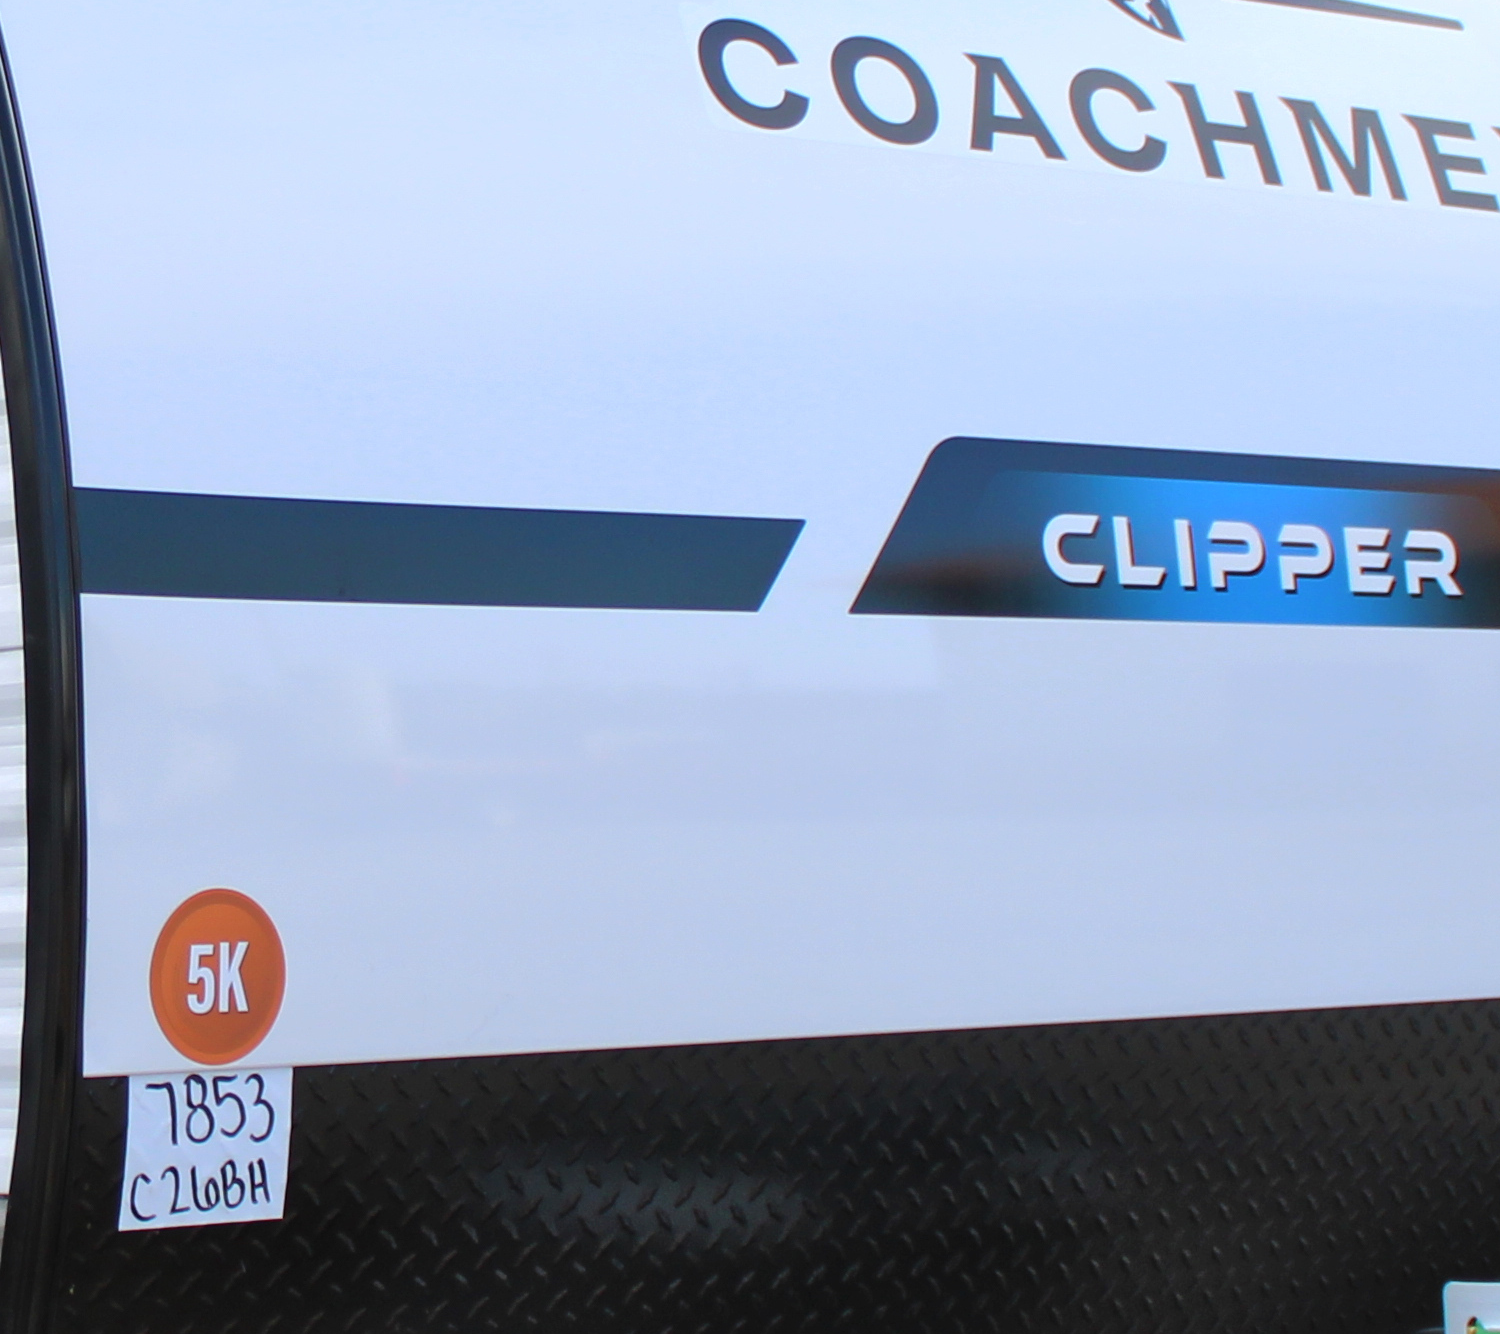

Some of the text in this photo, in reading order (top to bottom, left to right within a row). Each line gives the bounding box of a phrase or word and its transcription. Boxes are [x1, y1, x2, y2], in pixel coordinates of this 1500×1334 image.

[1042, 512, 1463, 598] CLIPPER
[186, 940, 250, 1015] 5K
[146, 1073, 275, 1146] 7853
